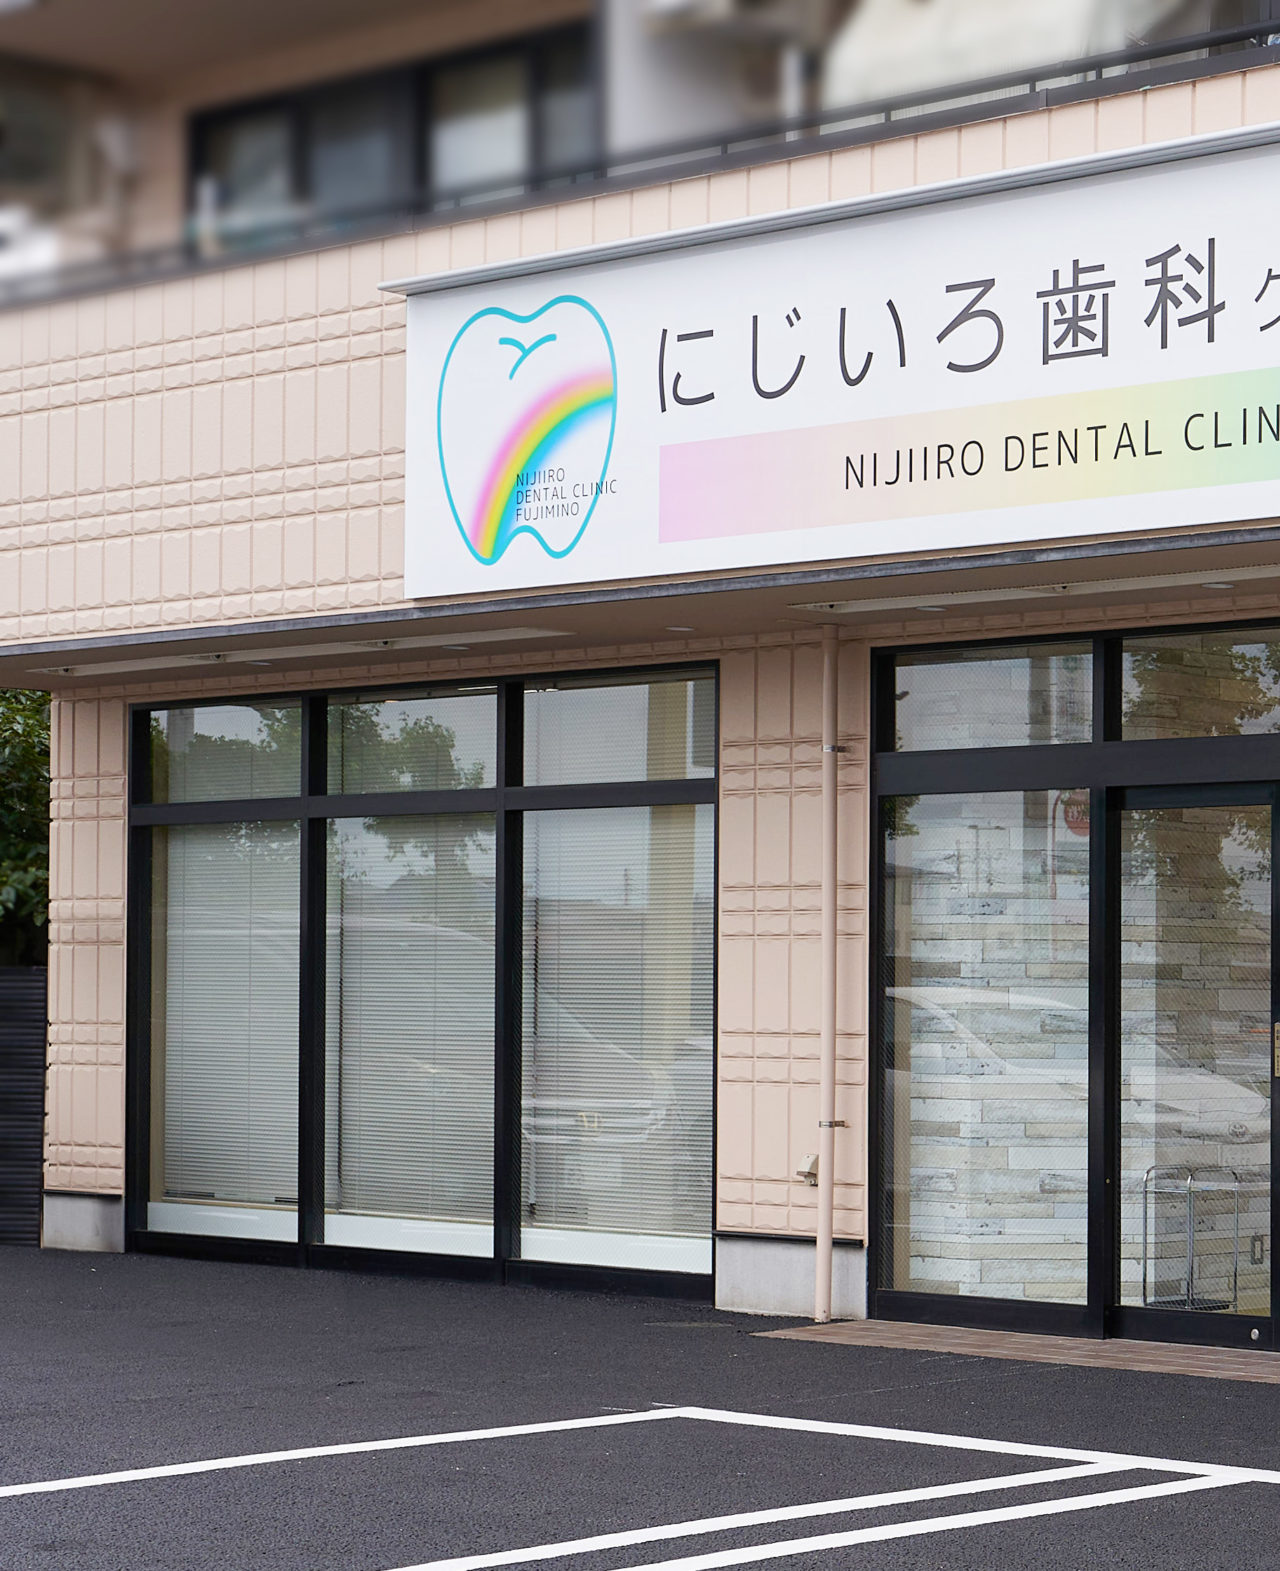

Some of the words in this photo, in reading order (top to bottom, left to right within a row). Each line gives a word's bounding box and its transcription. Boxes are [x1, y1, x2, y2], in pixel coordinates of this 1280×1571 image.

[658, 237, 1226, 413] にじいろ歯科
[845, 440, 984, 490] NIJIIRO
[1004, 419, 1163, 472] DENTAL
[516, 467, 565, 488] NIJIIRO
[516, 486, 567, 505] DENTAL
[572, 479, 617, 498] CLINIC
[515, 501, 580, 522] FUJIMINO
